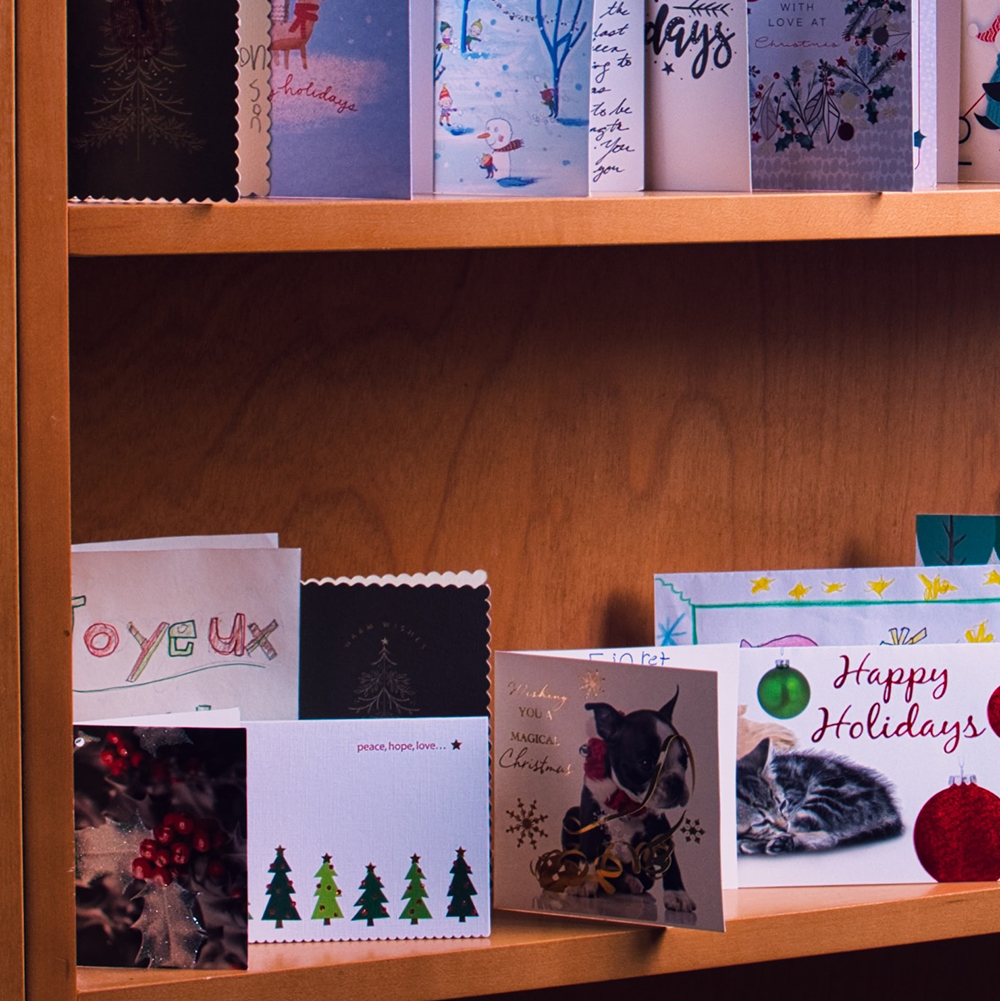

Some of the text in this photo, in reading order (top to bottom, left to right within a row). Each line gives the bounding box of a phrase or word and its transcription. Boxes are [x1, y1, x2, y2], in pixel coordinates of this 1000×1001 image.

[780, 2, 815, 12] WITH
[768, 17, 827, 27] LOVE AT
[278, 73, 359, 114] holidays
[833, 652, 948, 704] Happy
[518, 706, 543, 719] YOU
[811, 702, 987, 755] Holidays
[357, 742, 387, 753] peace,
[388, 741, 415, 752] hope,
[510, 731, 561, 747] MAGICAL
[498, 747, 574, 776] Christmas
